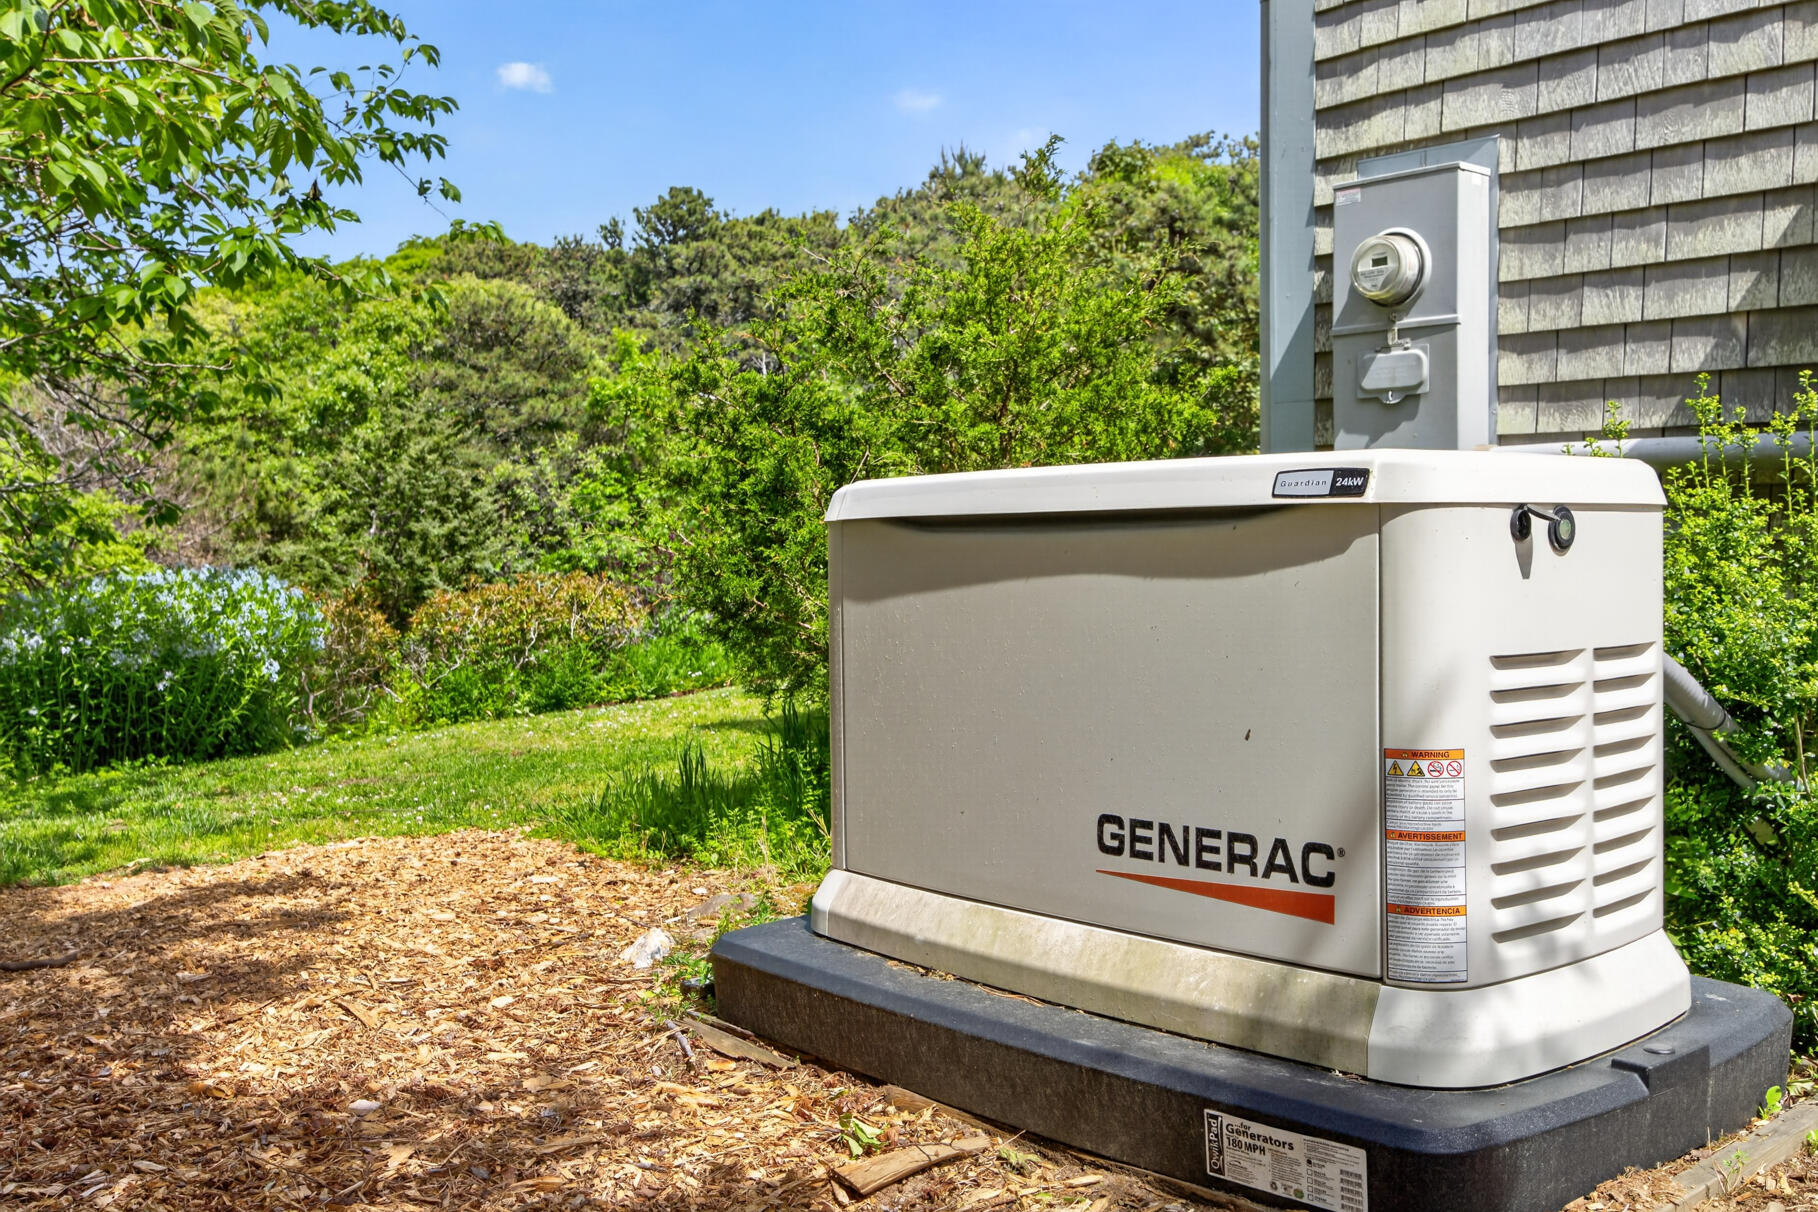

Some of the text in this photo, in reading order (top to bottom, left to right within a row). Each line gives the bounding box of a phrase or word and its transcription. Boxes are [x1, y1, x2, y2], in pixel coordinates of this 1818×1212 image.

[1336, 477, 1364, 486] 24kW
[1411, 751, 1450, 759] WARNING
[1398, 832, 1463, 840] AVERTISSEMENT
[1404, 906, 1461, 915] ADVERTENCIA
[1225, 1123, 1295, 1151] Generators
[1226, 1136, 1243, 1150] 180
[1244, 1141, 1266, 1156] MPH
